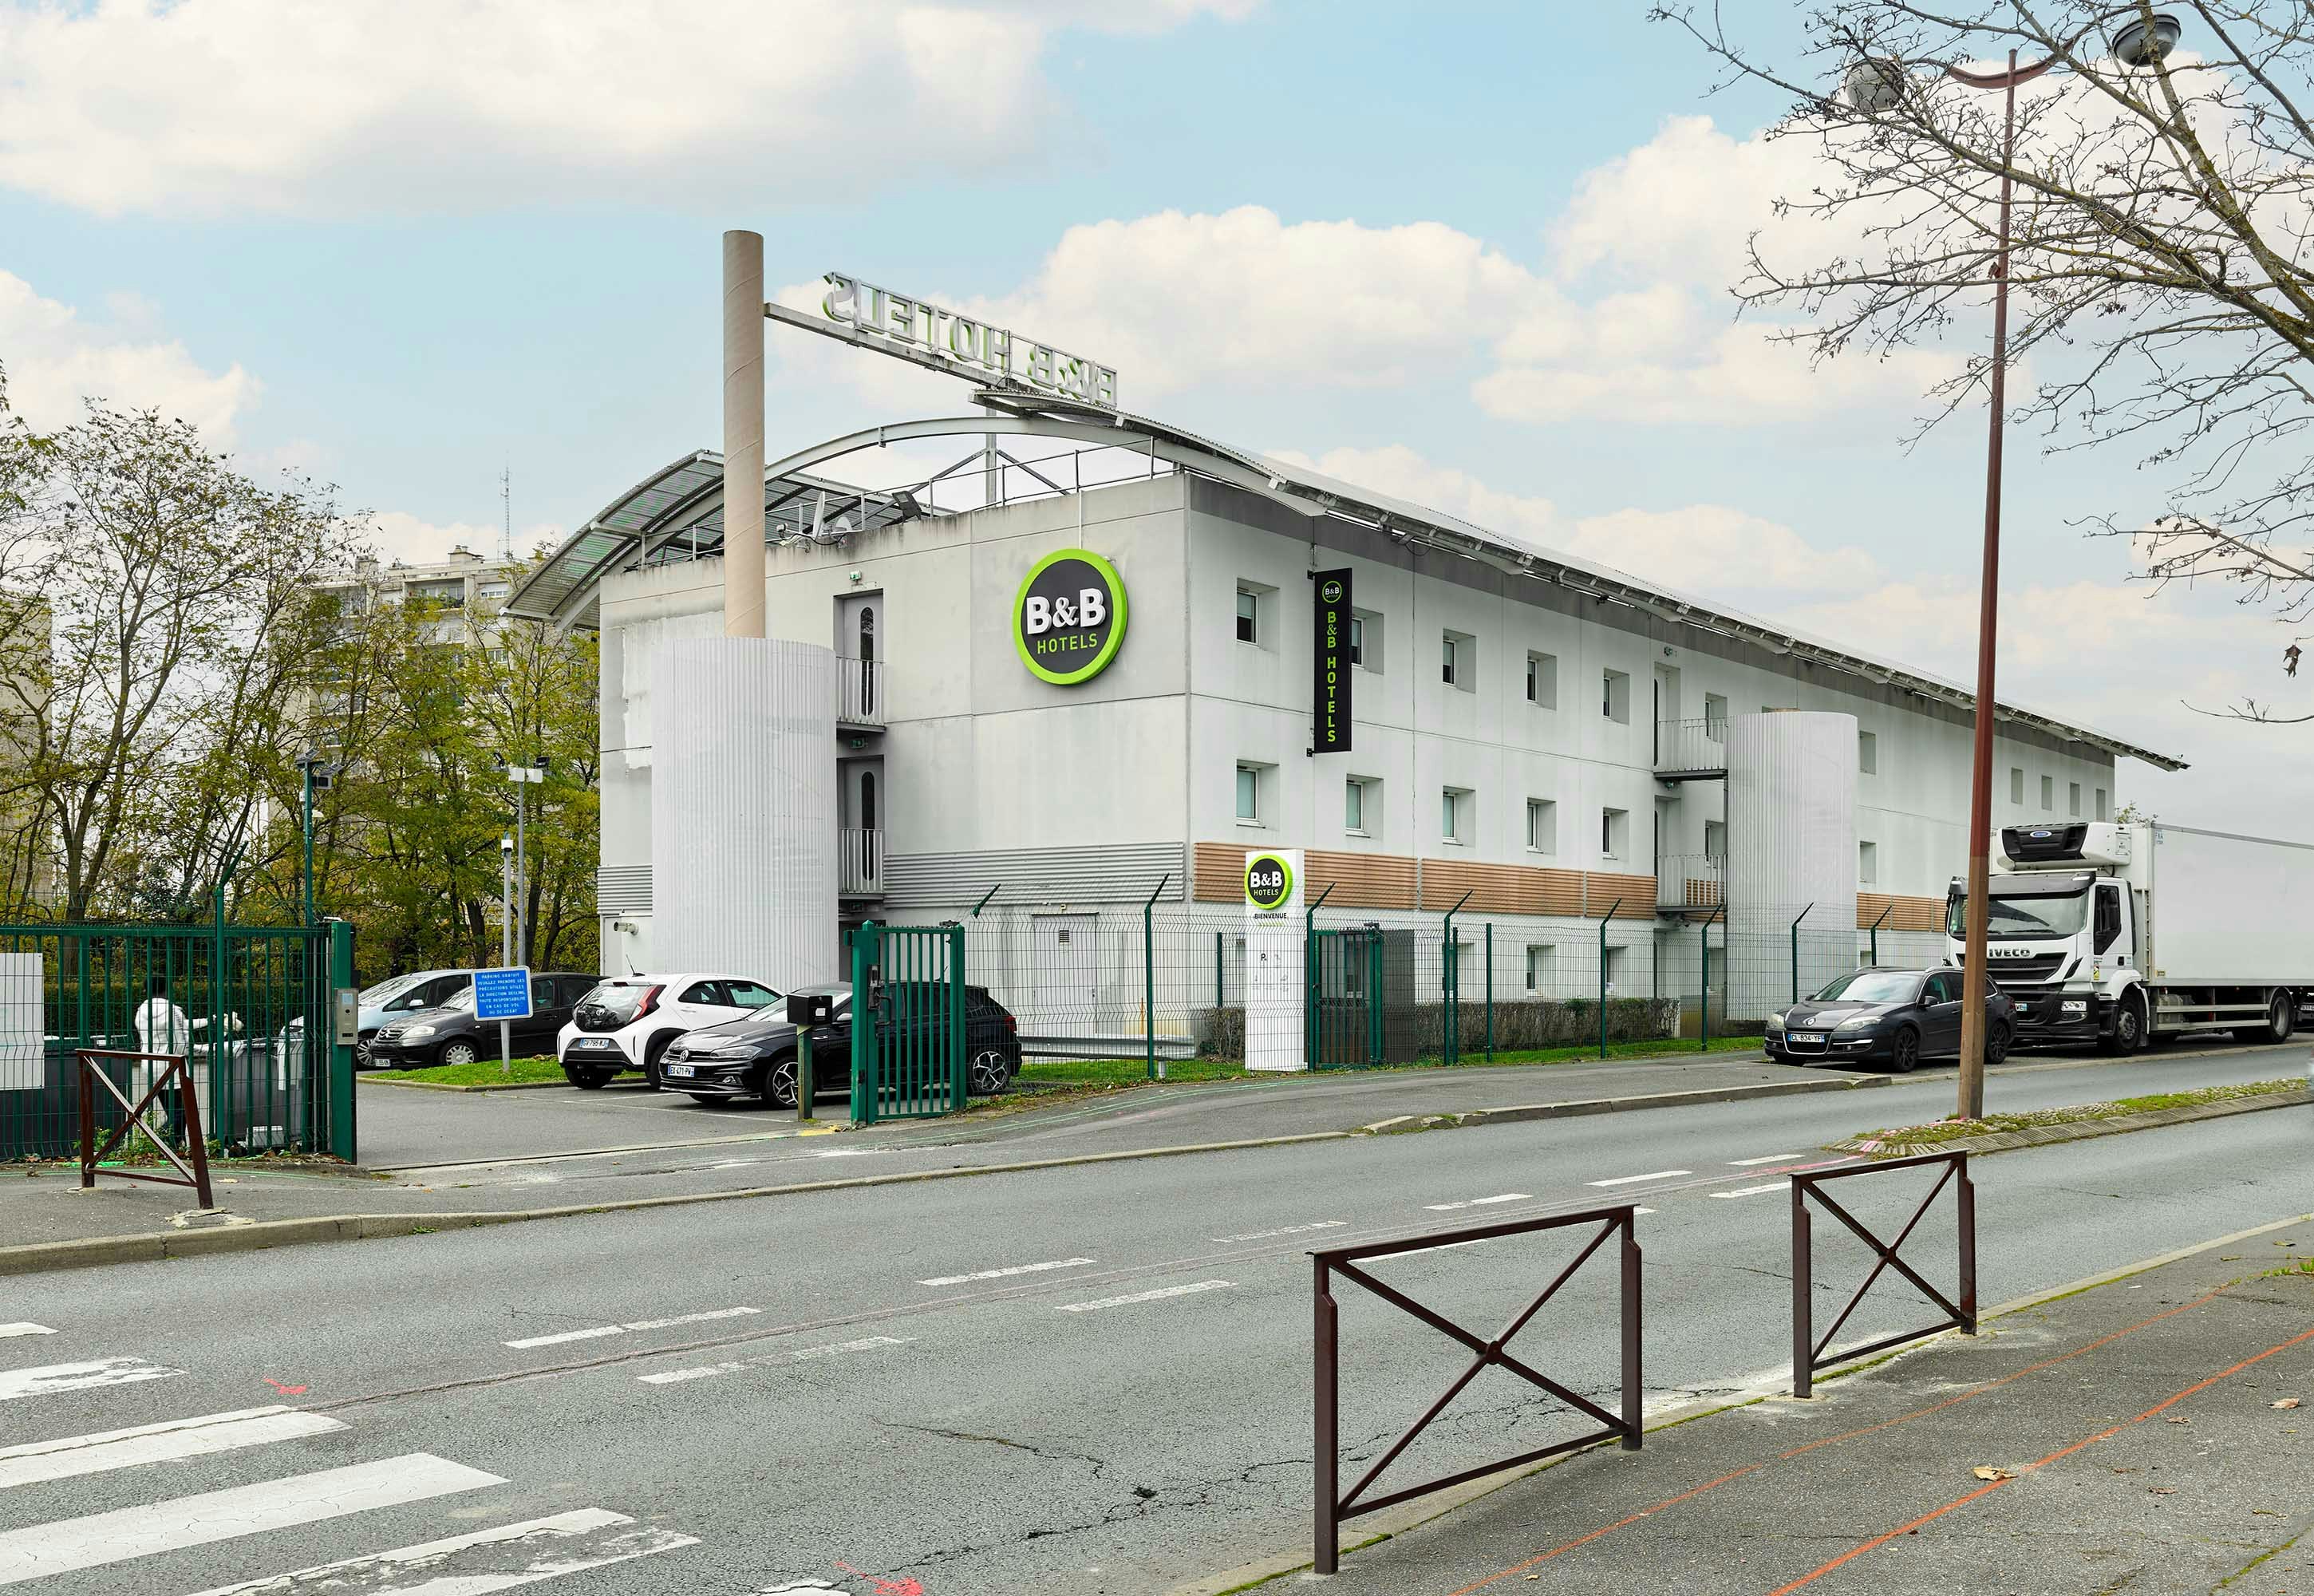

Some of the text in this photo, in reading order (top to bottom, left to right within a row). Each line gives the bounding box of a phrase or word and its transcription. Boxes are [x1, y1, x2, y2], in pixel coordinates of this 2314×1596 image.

[1325, 587, 1340, 595] B&B
[1026, 588, 1106, 634] B&B
[1037, 634, 1098, 654] HOTELS
[1327, 611, 1337, 742] B&B HOTELS
[1250, 871, 1282, 888] B&B
[1989, 948, 2031, 958] IVECO
